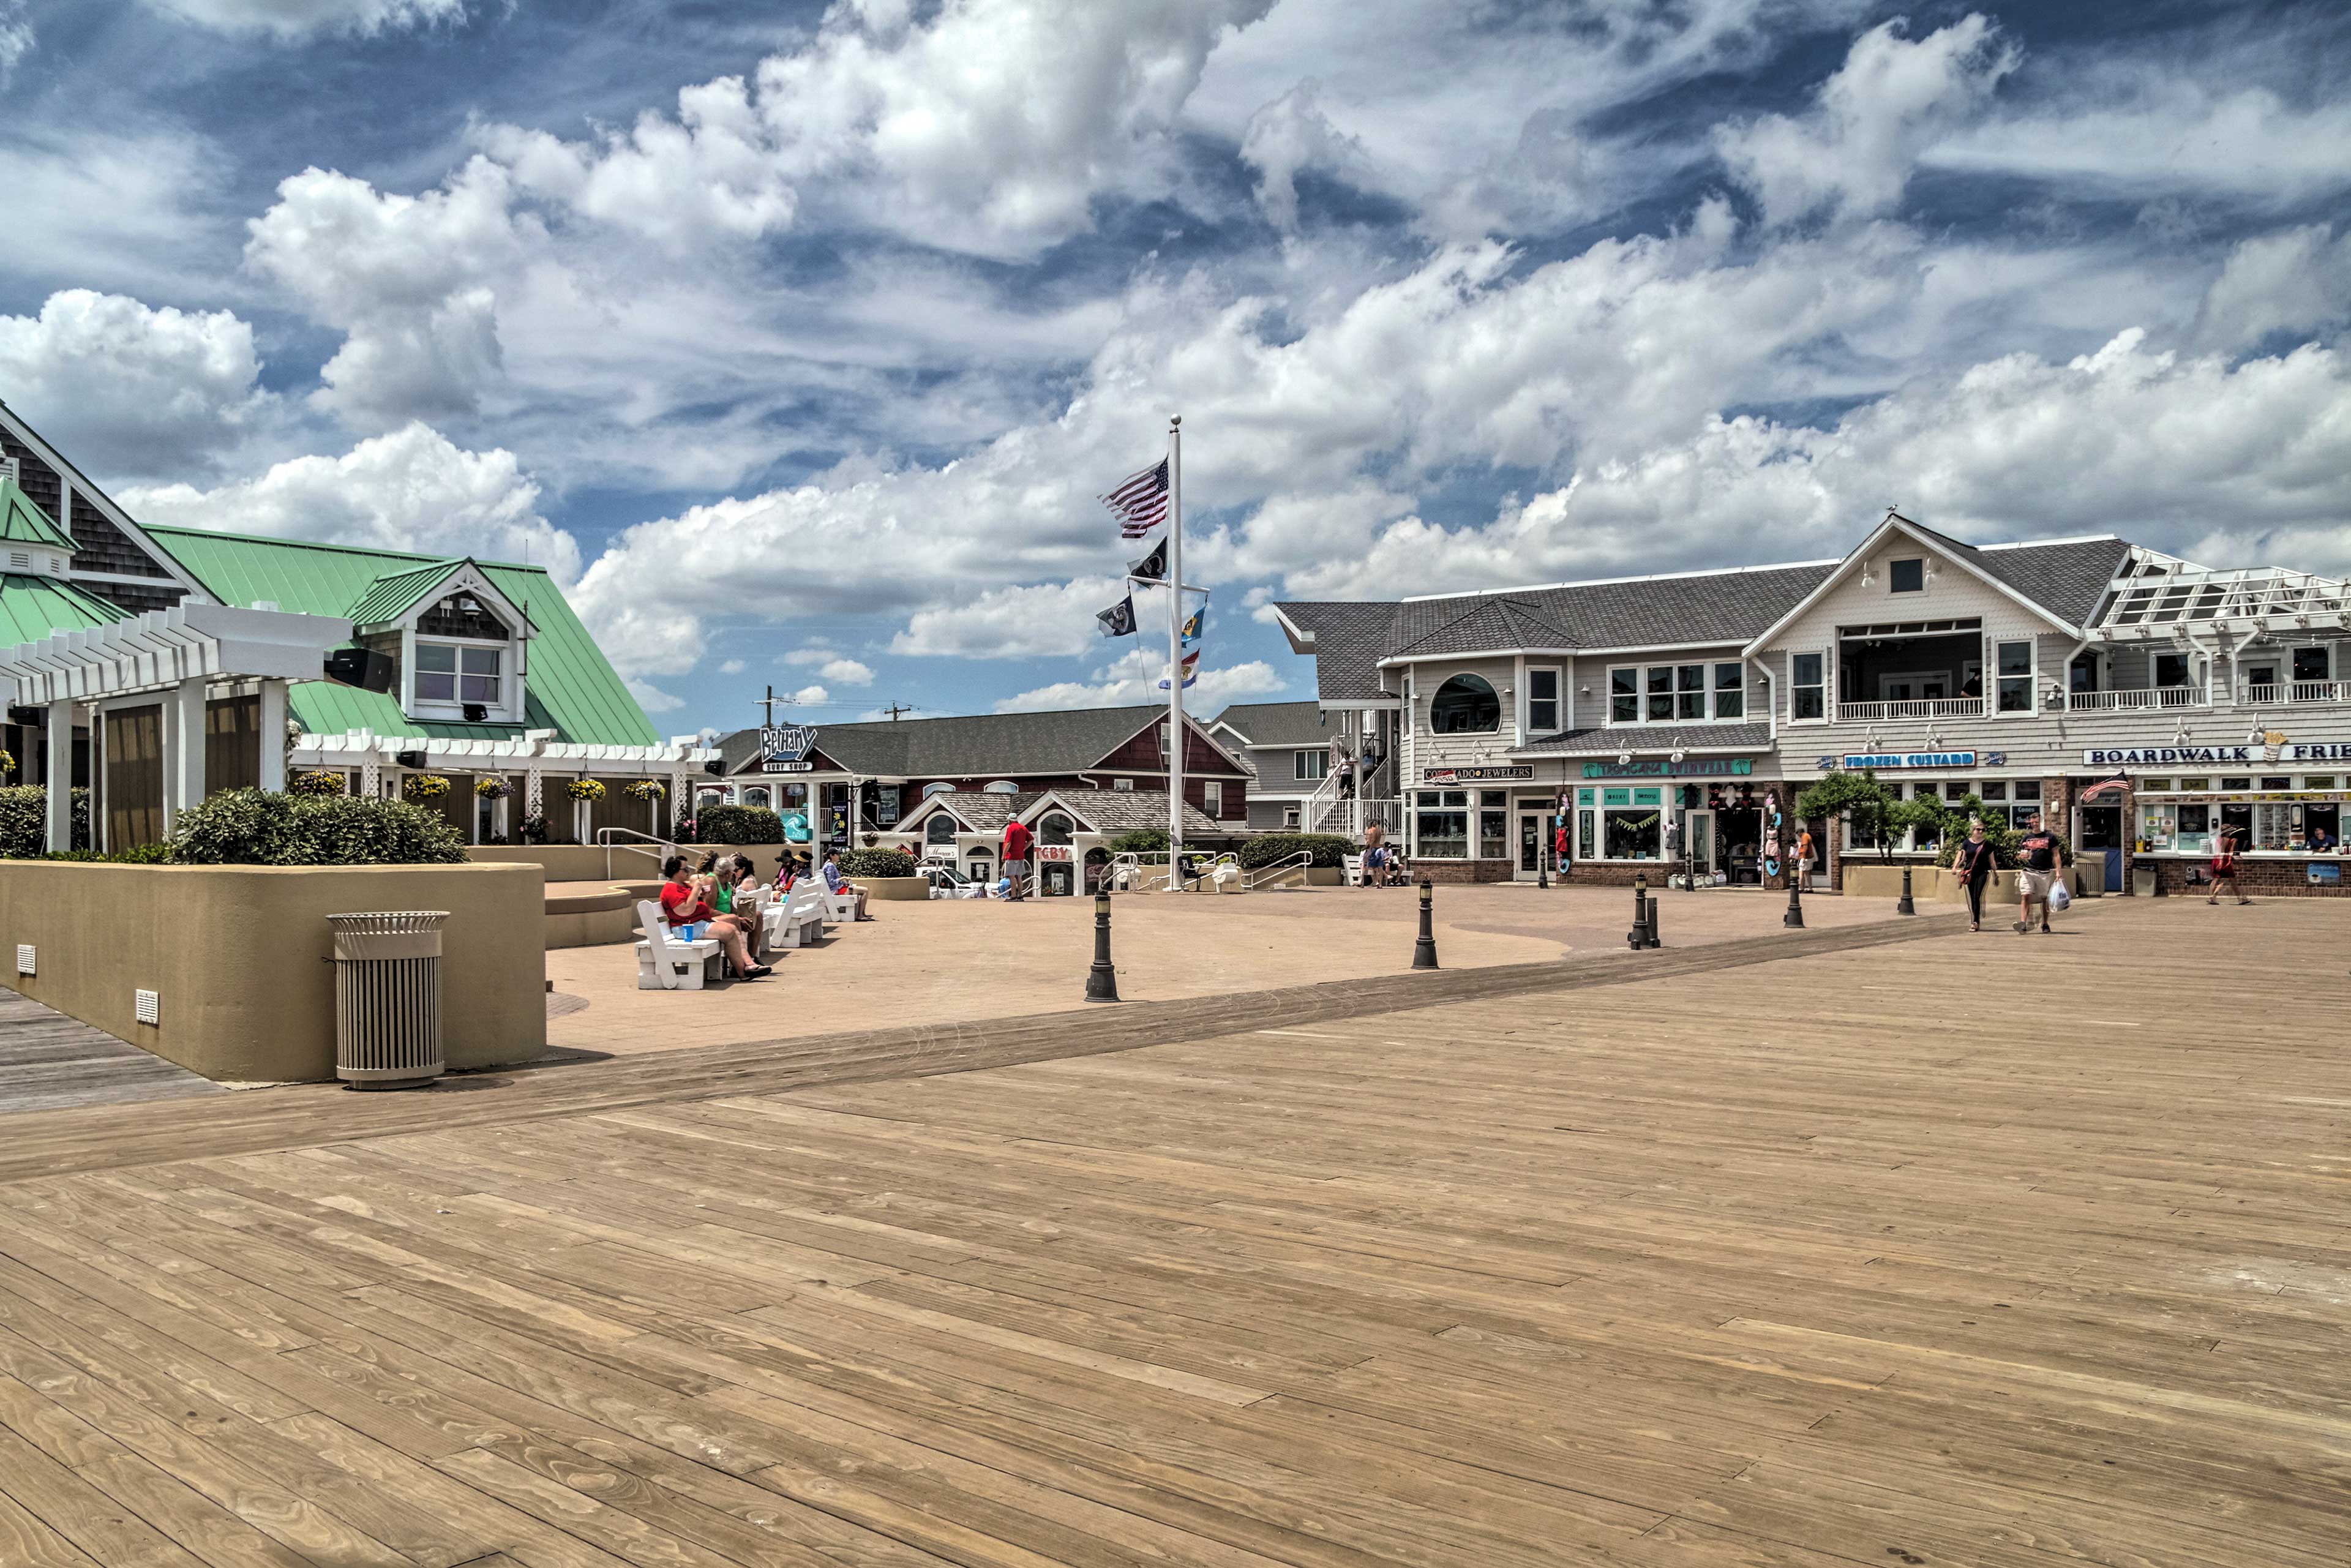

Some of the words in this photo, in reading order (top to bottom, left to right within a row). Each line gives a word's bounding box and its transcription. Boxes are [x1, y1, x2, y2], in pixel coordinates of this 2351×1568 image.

[1845, 754, 1901, 767] FROZEN
[1907, 753, 1973, 766] CUSTARD
[2091, 748, 2249, 762] BOARDWALK
[2293, 745, 2351, 758] FRIE
[1425, 769, 1475, 779] COADO
[1482, 768, 1530, 778] JEWELERS
